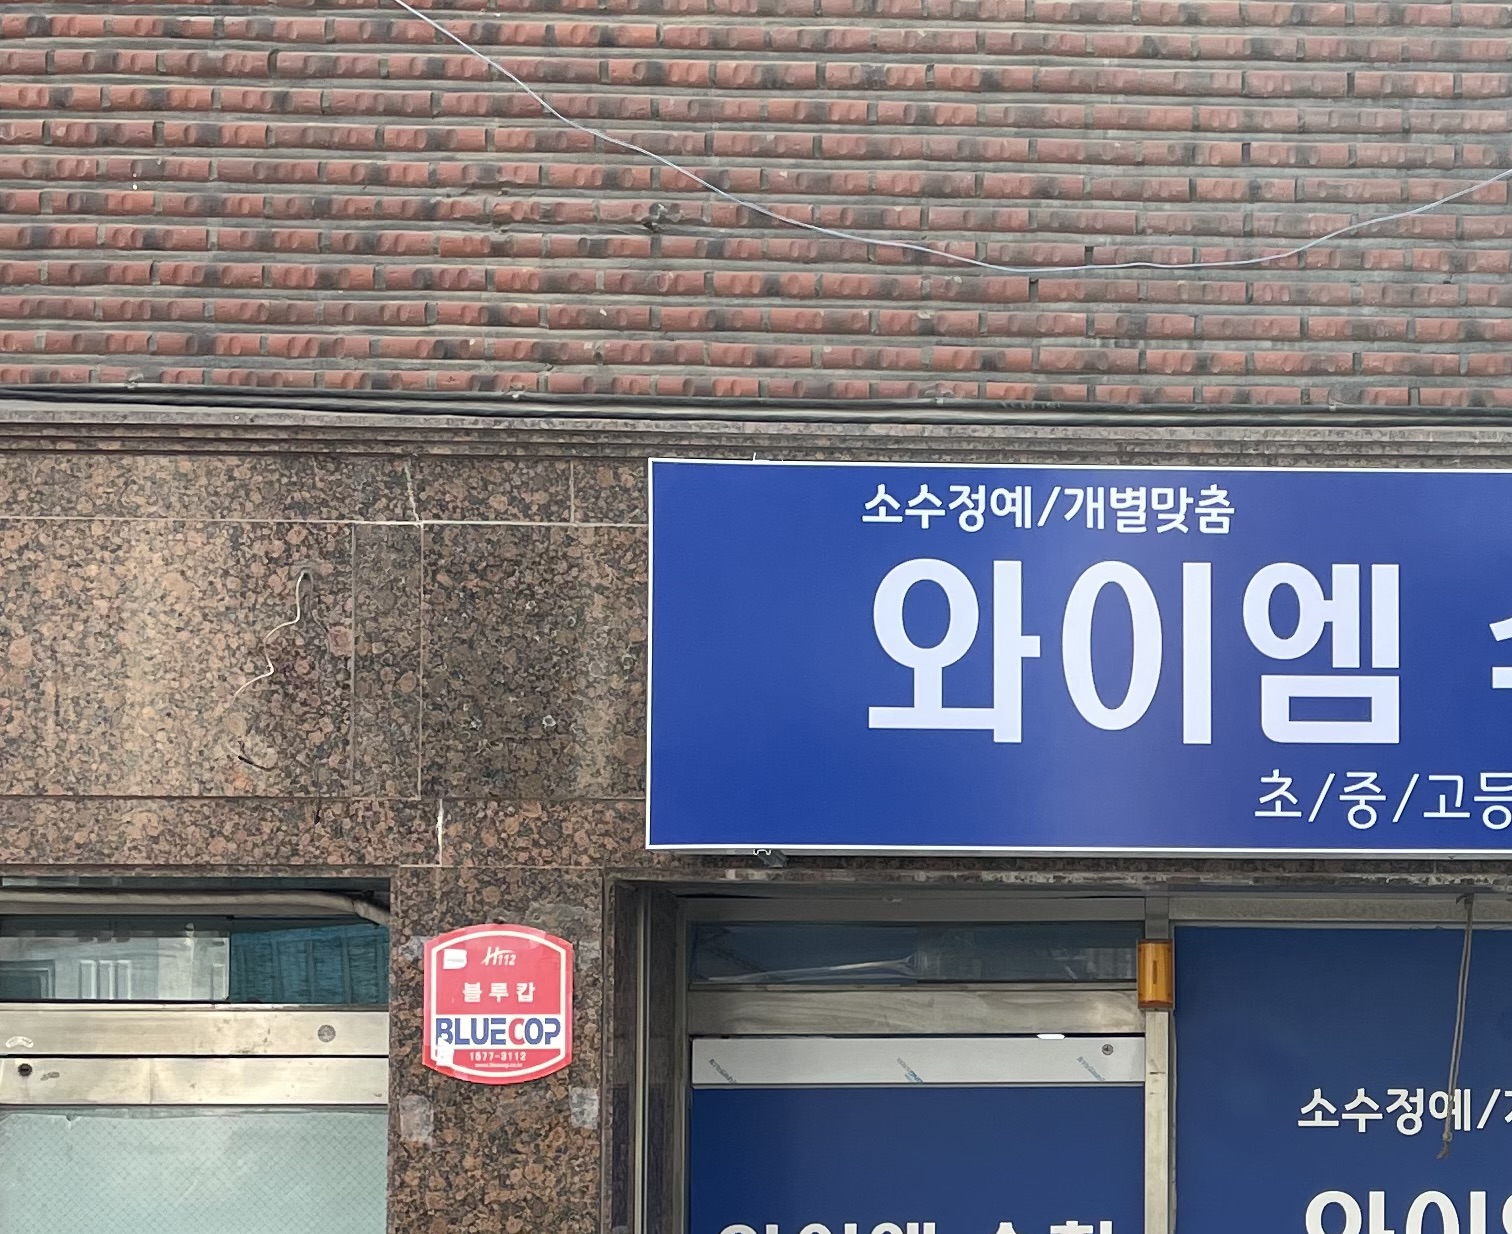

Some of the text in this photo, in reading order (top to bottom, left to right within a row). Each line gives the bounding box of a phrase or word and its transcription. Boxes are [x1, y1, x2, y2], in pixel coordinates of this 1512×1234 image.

[862, 483, 1235, 534] 소수정예/개별맞춤
[868, 558, 1400, 745] 와이엠
[435, 1017, 562, 1046] BLUECOP
